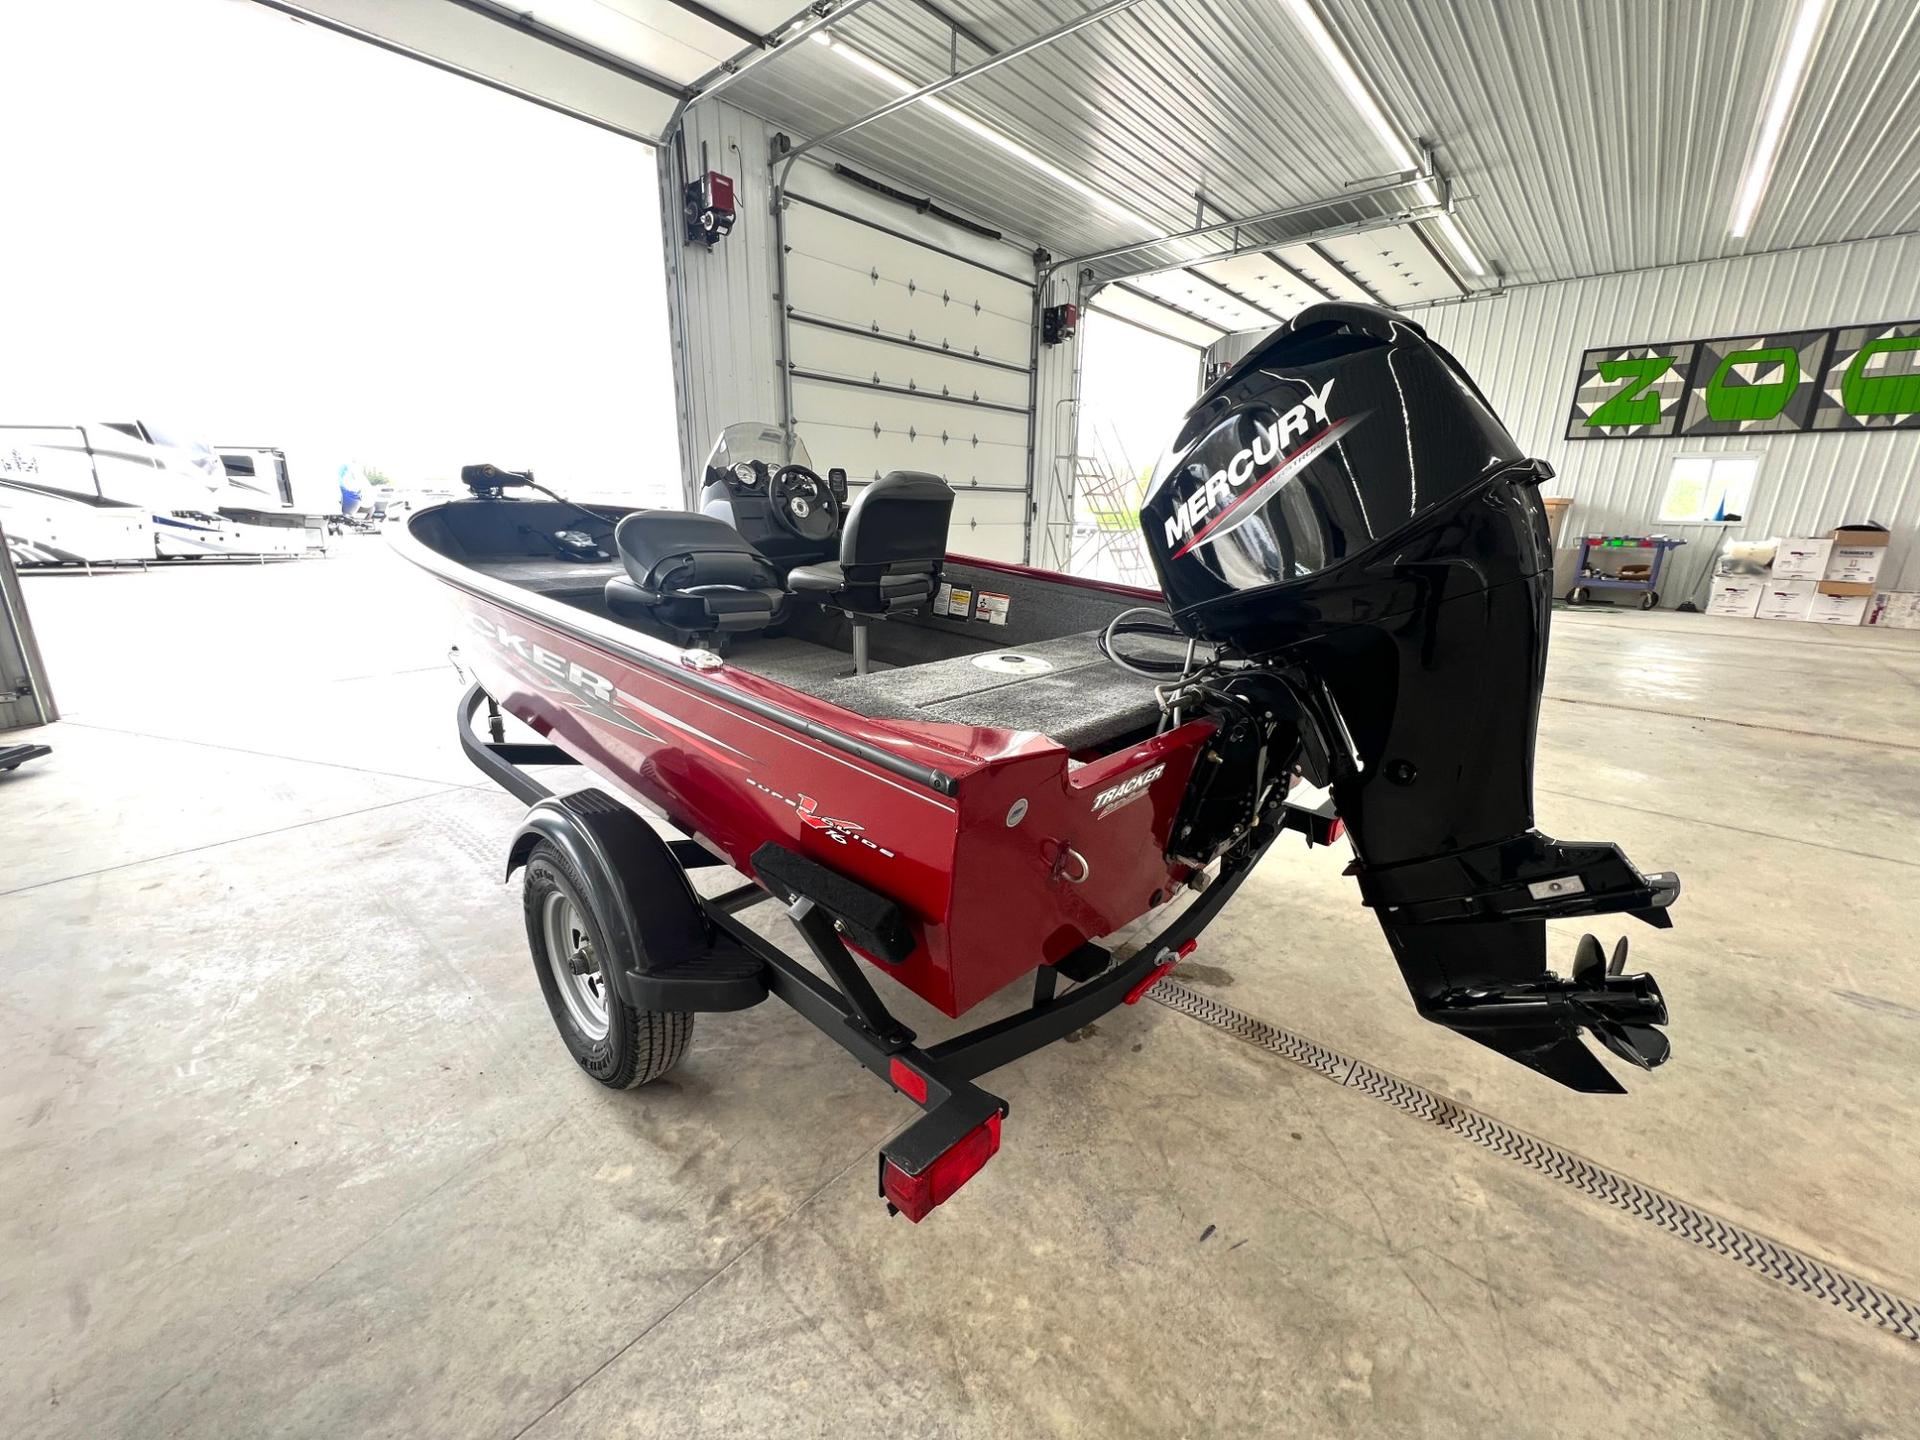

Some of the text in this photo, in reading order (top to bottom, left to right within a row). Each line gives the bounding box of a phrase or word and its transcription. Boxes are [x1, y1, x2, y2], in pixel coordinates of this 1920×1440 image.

[1164, 378, 1336, 549] MERCURY
[1092, 763, 1166, 811] TRACKER
[825, 829, 848, 845] 16
